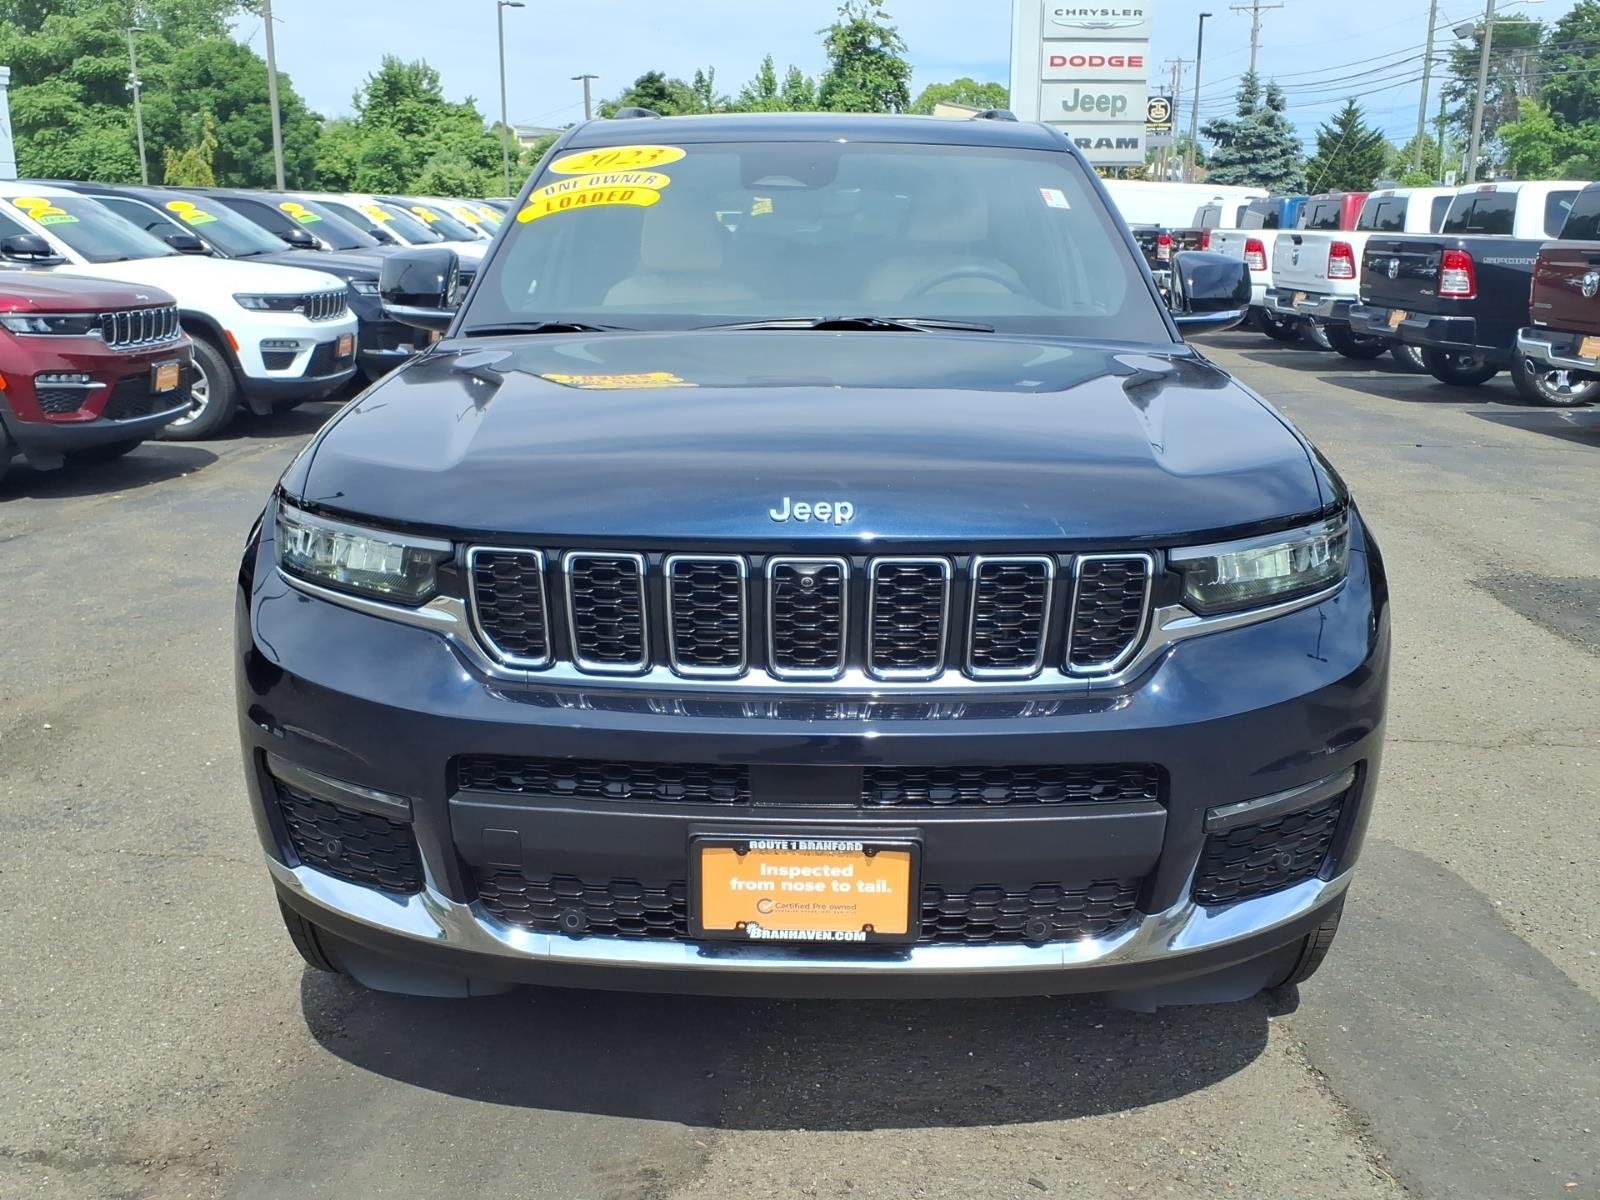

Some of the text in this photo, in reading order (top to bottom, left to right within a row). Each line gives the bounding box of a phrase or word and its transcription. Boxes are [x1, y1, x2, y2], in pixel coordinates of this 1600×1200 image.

[1050, 55, 1143, 68] DODGE
[1062, 88, 1128, 118] Jeep
[1073, 137, 1139, 149] RAM
[570, 149, 665, 170] 2023
[544, 173, 659, 196] ONE OWNER
[545, 189, 635, 213] LOADED
[769, 497, 854, 526] Jeep
[749, 840, 864, 851] ROUTE 1 BRANFORD
[761, 864, 854, 879] Inspected
[730, 878, 893, 893] from nose to tail.
[775, 902, 810, 910] Certified
[748, 925, 867, 942] BRANHAVEN.COM
